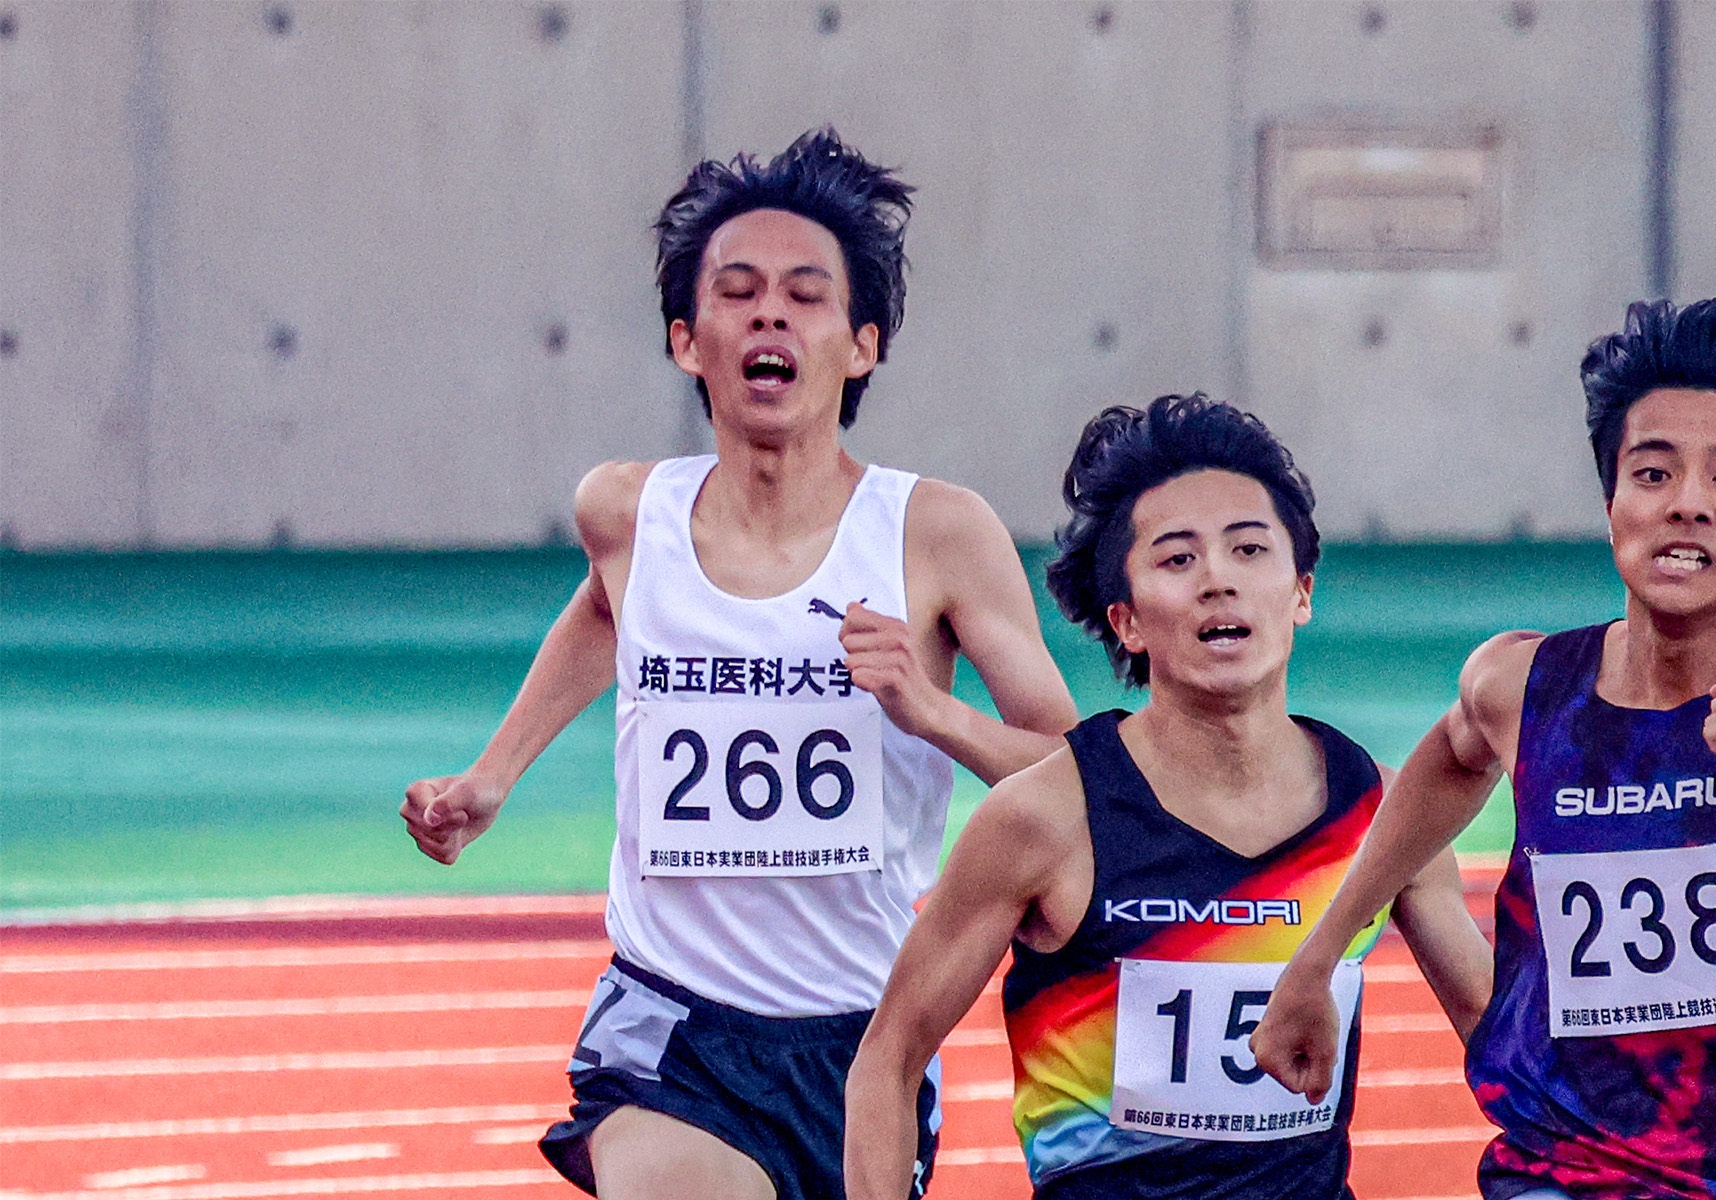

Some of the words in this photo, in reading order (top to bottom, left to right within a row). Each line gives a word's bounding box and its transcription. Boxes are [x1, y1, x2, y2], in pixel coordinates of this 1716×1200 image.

[638, 655, 855, 698] 埼玉医科大学
[662, 729, 855, 821] 266
[649, 844, 870, 868] 第66回東日本実業団陸上競技選手権大会
[1104, 898, 1300, 925] KOMORI
[1156, 989, 1273, 1085] 15
